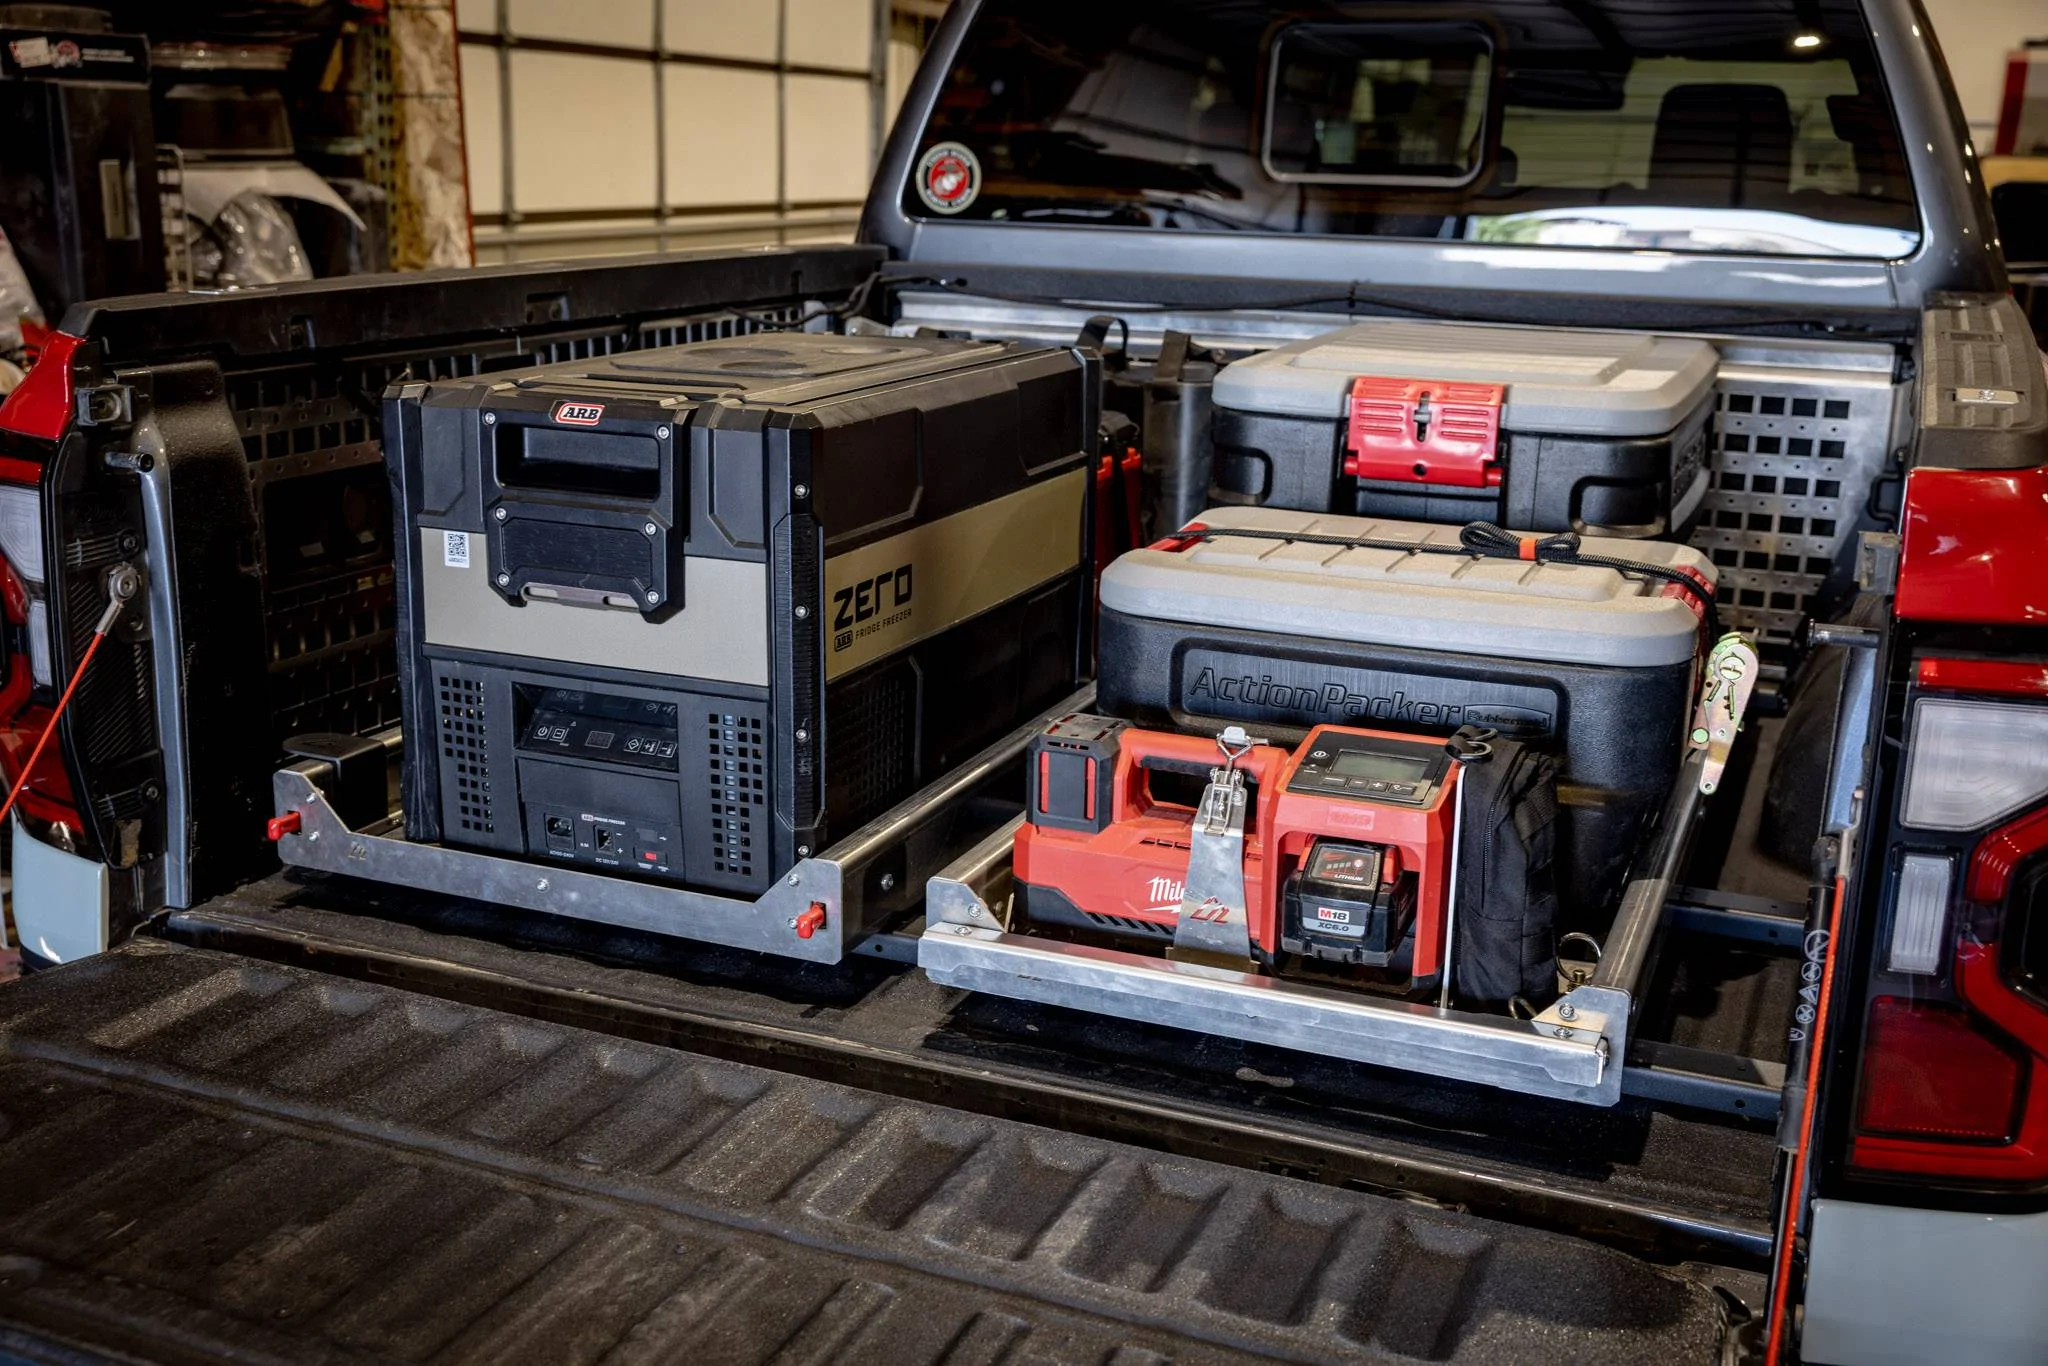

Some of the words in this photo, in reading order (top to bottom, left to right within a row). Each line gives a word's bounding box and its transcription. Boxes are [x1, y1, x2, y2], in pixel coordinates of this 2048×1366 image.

[563, 407, 599, 420] ARB
[836, 633, 852, 649] ARB
[855, 621, 881, 640] FRIDGE
[882, 608, 912, 629] FREEZER
[1189, 666, 1461, 727] ActionPacker
[1320, 909, 1347, 921] M18
[1317, 921, 1349, 932] XC6.0
